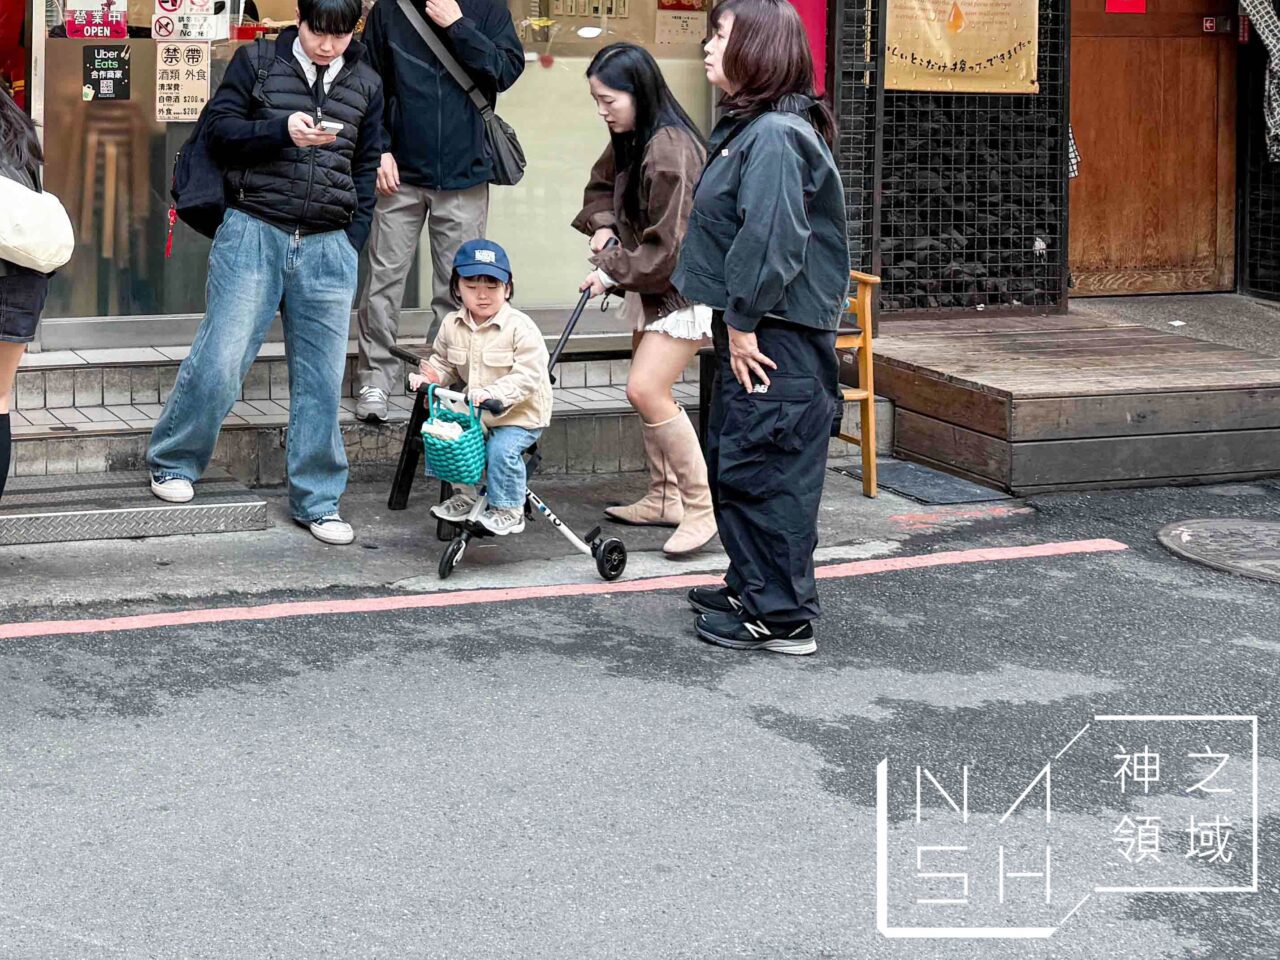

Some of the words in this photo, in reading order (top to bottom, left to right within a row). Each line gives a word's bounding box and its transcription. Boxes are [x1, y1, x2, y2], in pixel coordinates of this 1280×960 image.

[74, 10, 121, 25] 營業中
[83, 26, 111, 37] OPEN
[94, 49, 118, 59] Uber
[95, 60, 118, 69] Eats
[90, 70, 123, 79] 合作商家
[158, 69, 180, 81] 酒類
[185, 69, 207, 81] 外食
